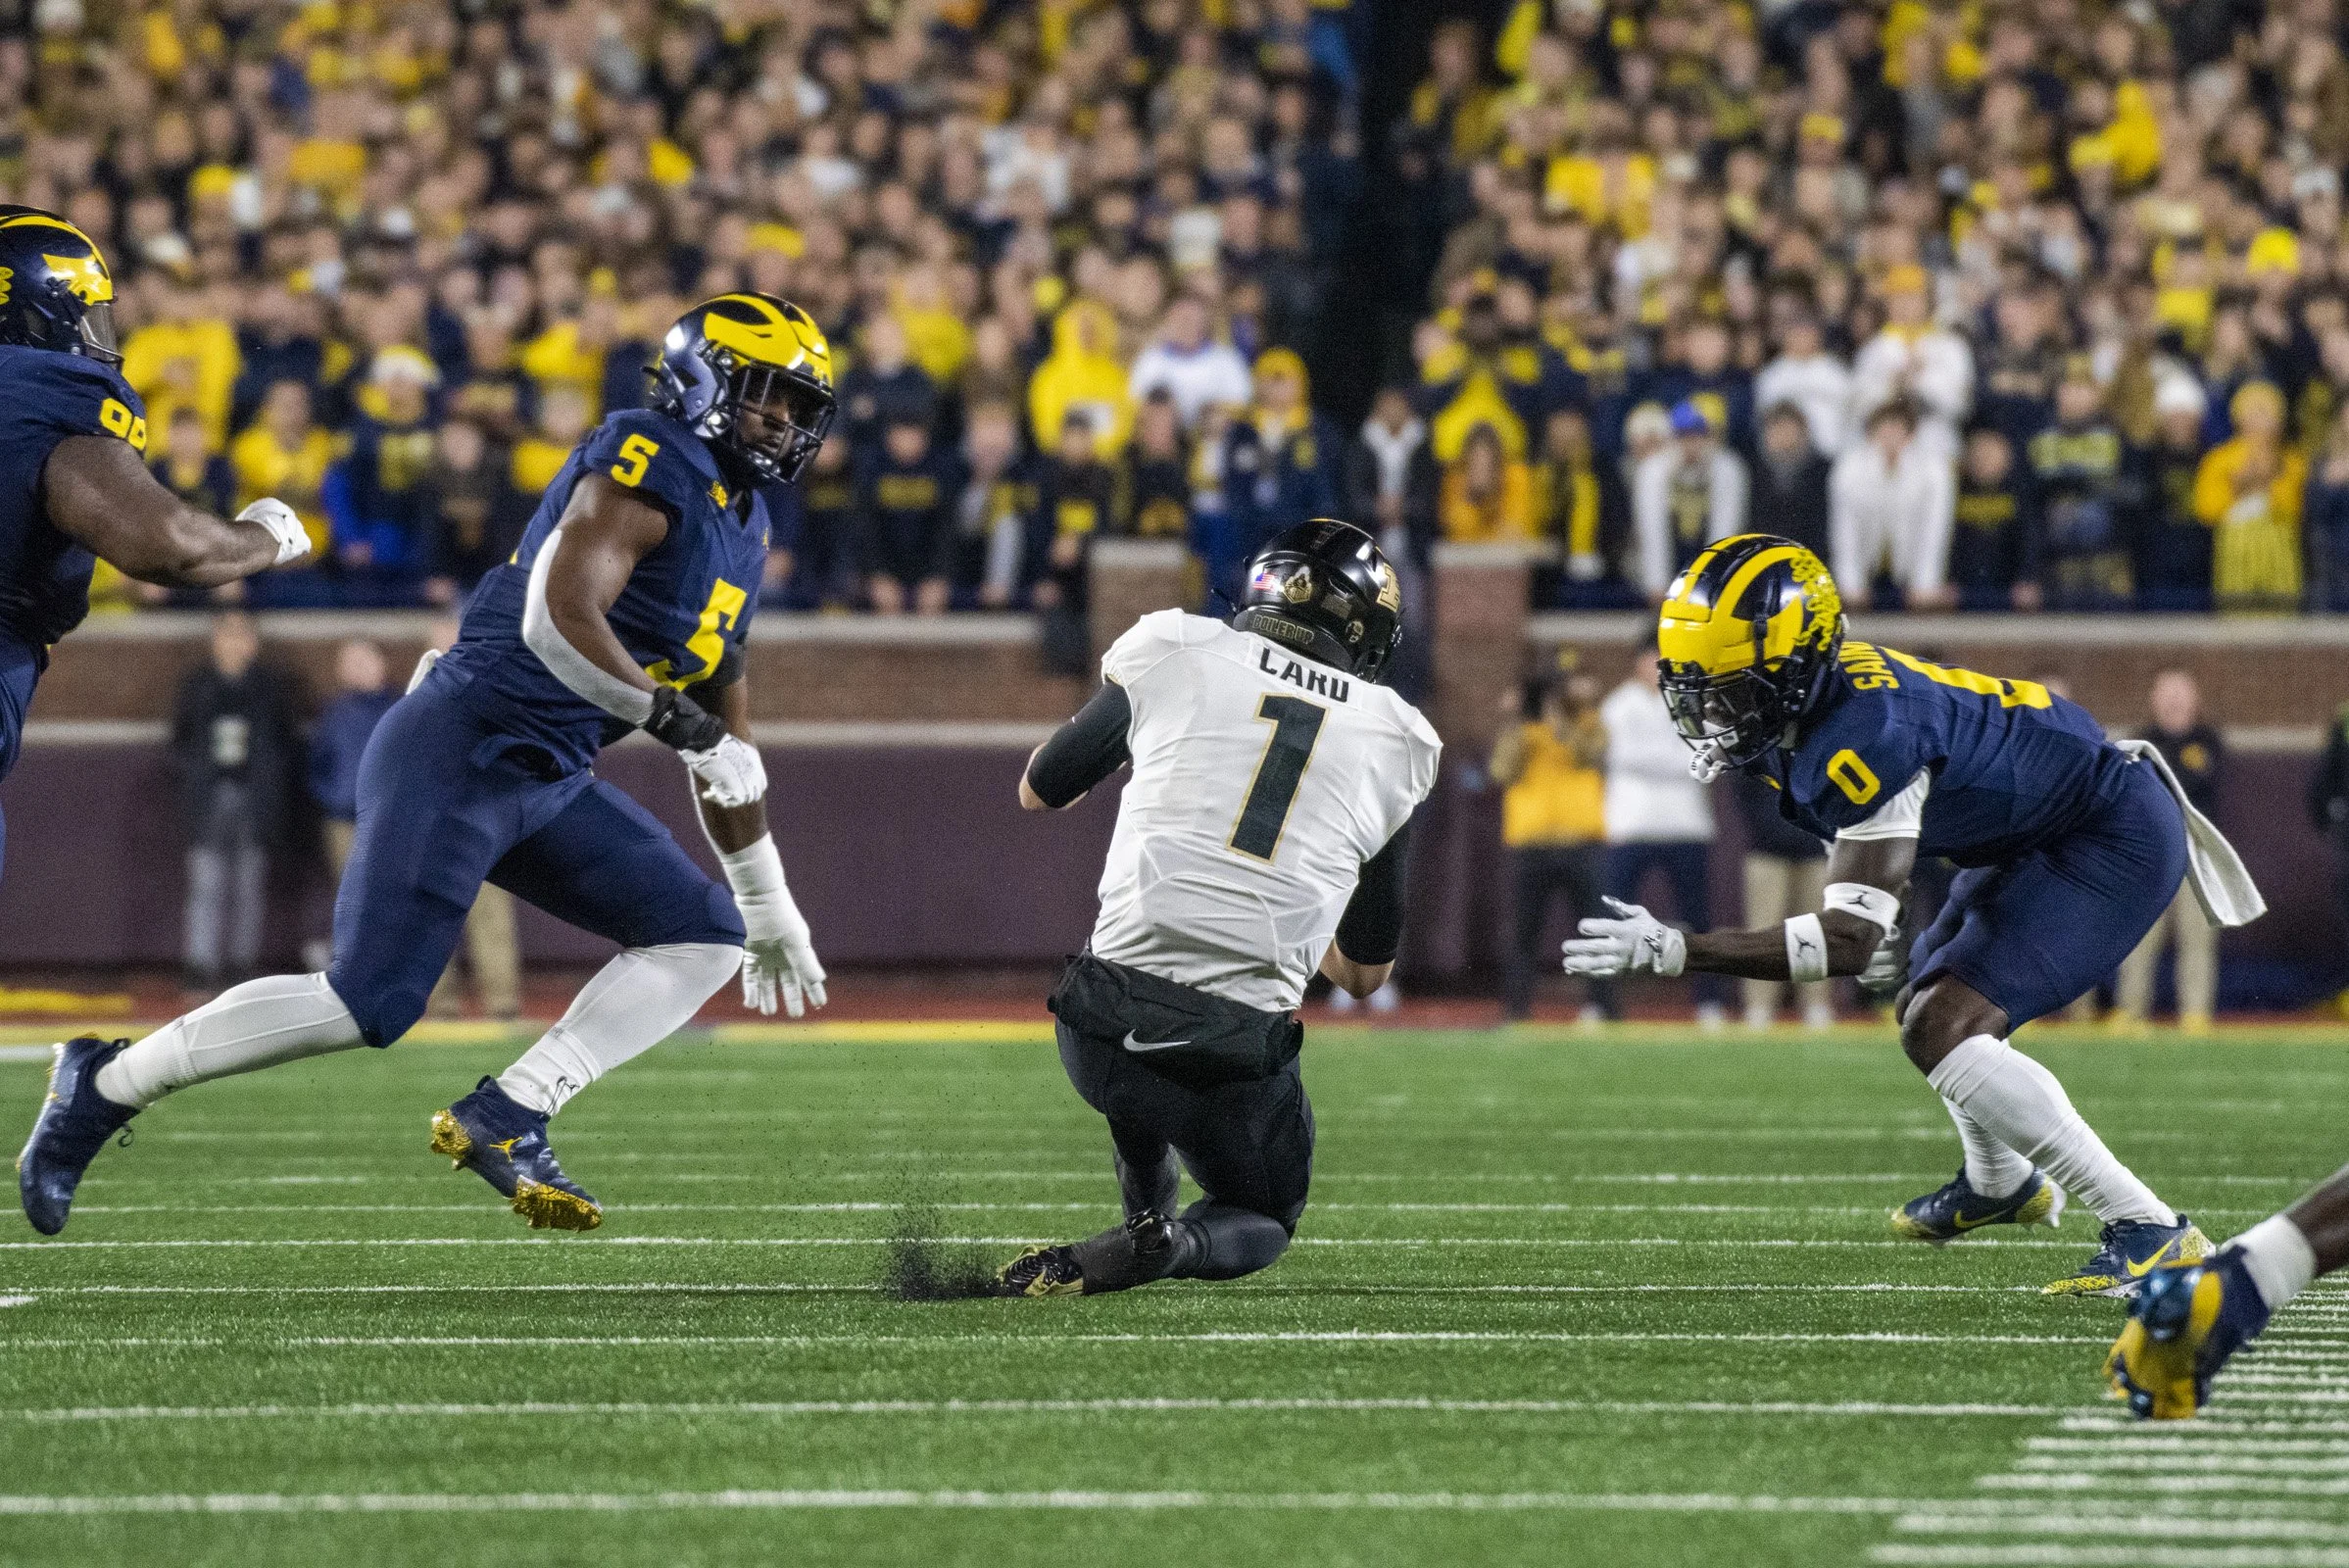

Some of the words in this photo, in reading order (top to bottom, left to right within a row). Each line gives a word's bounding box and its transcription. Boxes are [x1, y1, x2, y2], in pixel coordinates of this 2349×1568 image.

[611, 433, 660, 487] 5
[644, 577, 748, 693] 5
[1252, 614, 1296, 640] BOILER
[1294, 625, 1315, 646] UP
[1226, 692, 1331, 866] 1
[1826, 749, 1882, 805] 0
